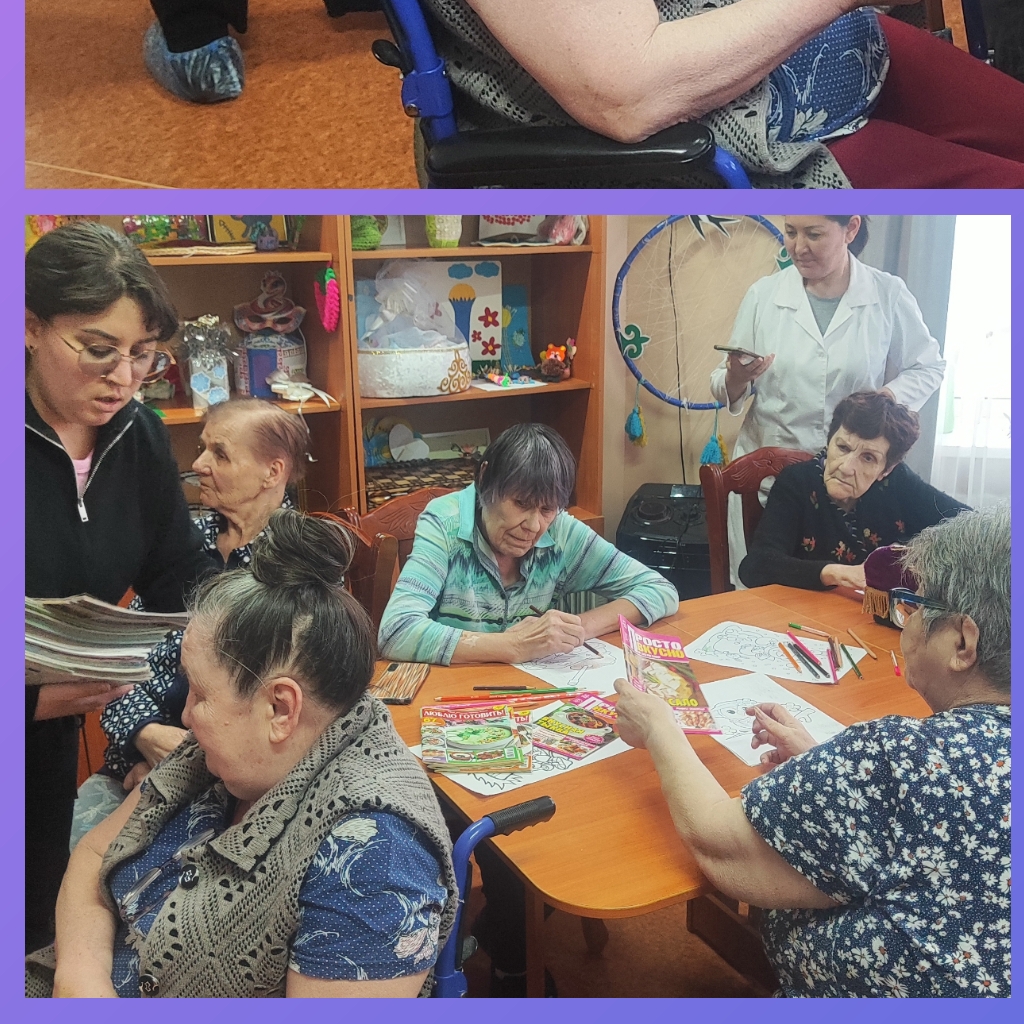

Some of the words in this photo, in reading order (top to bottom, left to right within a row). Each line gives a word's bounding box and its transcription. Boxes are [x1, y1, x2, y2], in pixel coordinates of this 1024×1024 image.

[627, 624, 682, 653] ПРОСТО
[636, 644, 685, 659] ВКУСНО
[668, 698, 698, 707] САЛО
[424, 710, 457, 720] ЛЮБЛЮ
[458, 708, 506, 720] ГОТОВИТЬ!
